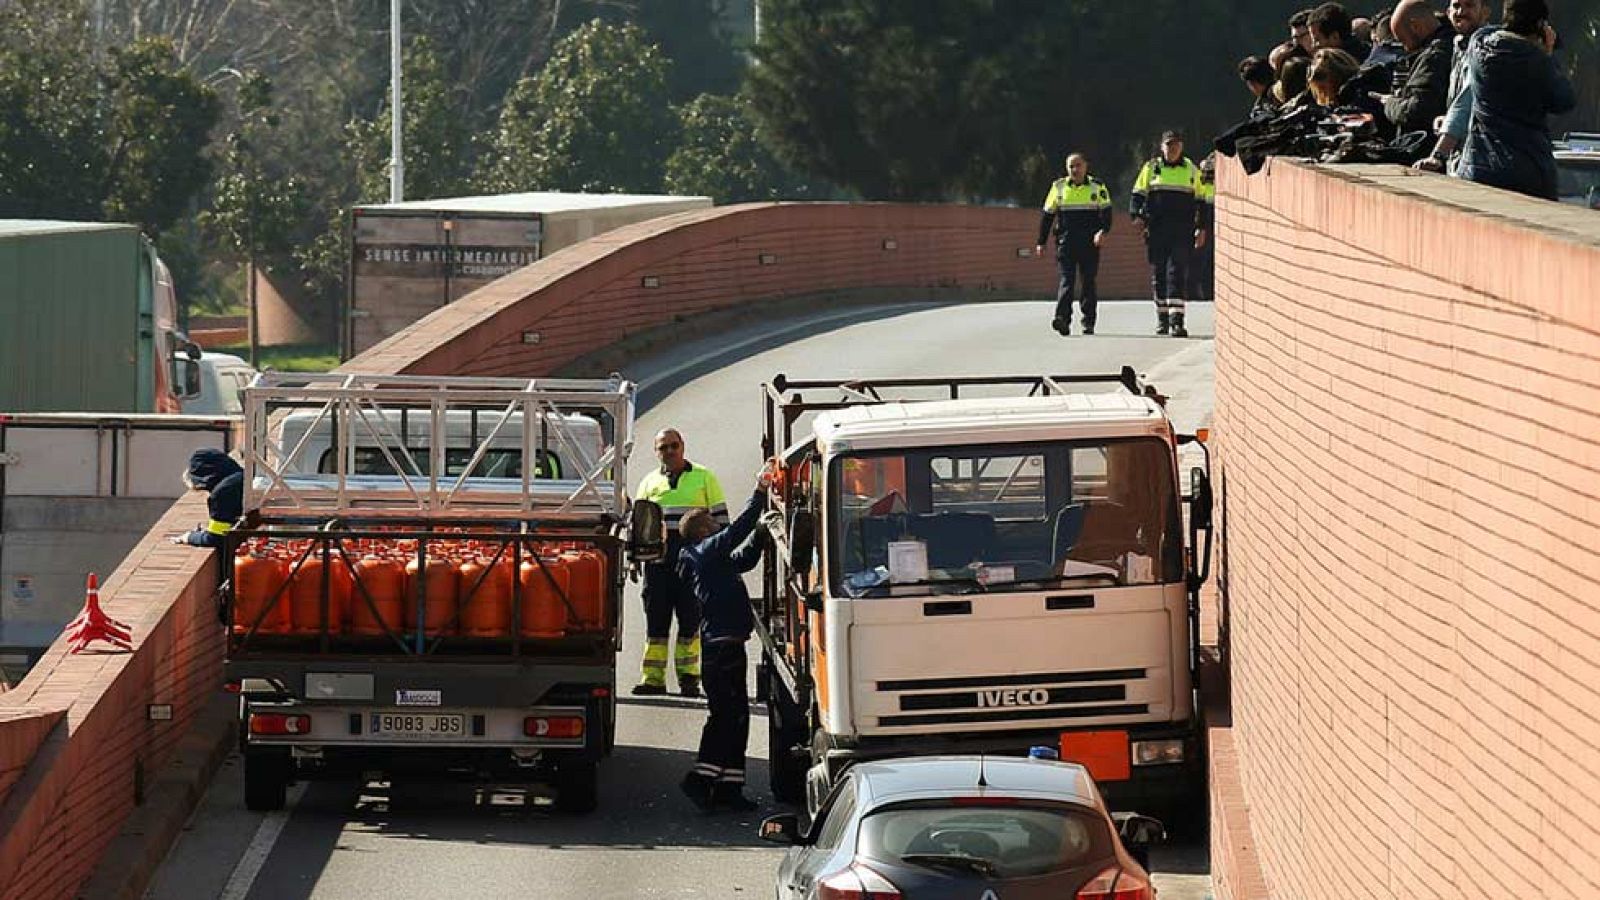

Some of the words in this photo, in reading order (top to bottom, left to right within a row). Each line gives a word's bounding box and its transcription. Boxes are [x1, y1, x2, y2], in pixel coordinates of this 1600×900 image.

[977, 690, 1049, 707] IVECO
[383, 716, 424, 731] 9083
[429, 716, 460, 732] JBS
